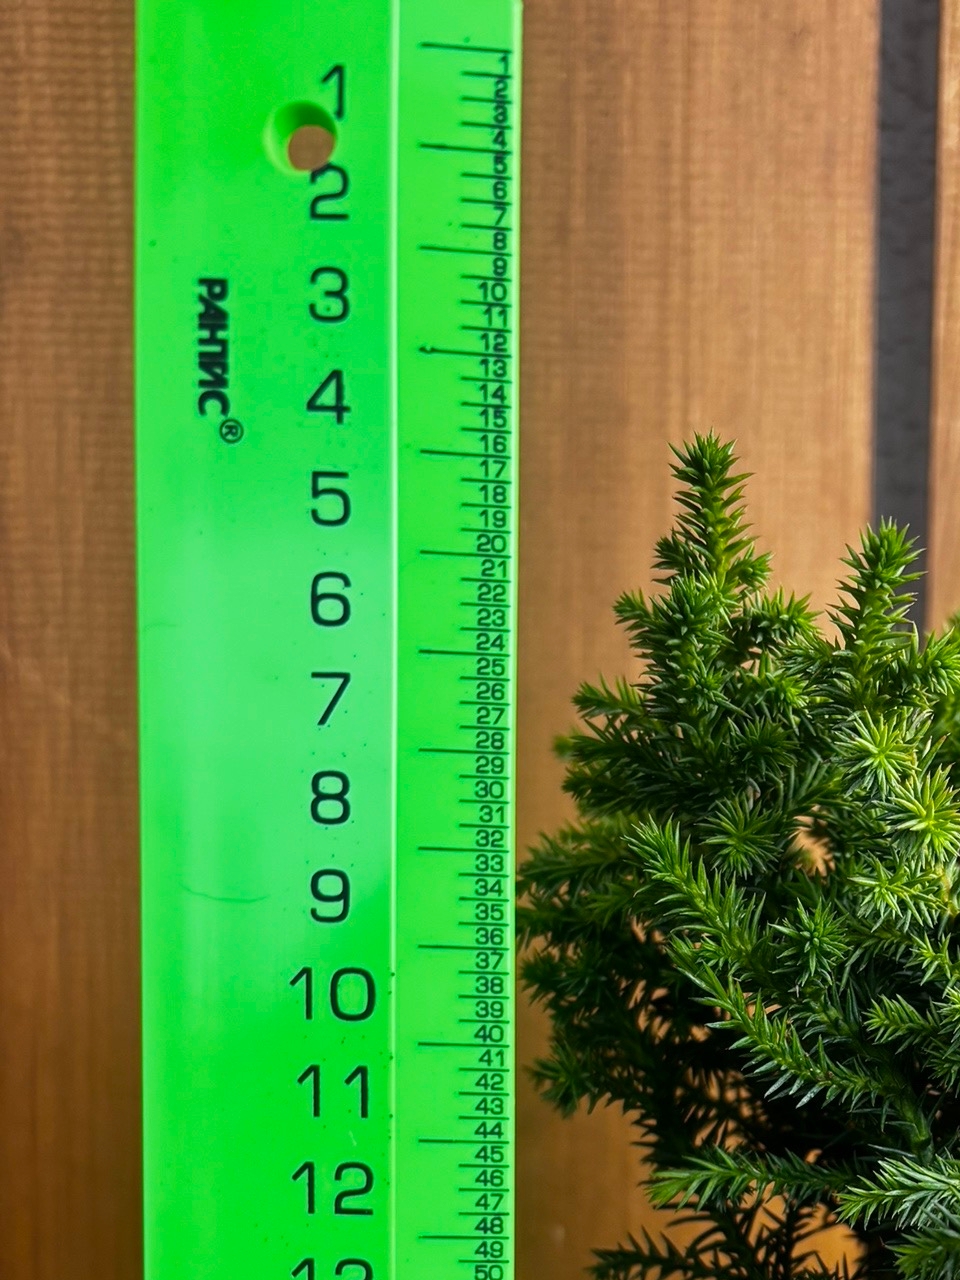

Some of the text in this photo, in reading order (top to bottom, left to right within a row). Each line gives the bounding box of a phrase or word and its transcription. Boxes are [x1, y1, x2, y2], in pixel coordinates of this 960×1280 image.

[499, 54, 509, 72] 1
[319, 65, 346, 120] 1
[492, 131, 507, 148] 4
[309, 165, 351, 220] 2
[492, 181, 507, 199] 6
[496, 207, 507, 225] 7
[492, 232, 507, 250] 8
[309, 266, 349, 323] 3
[478, 283, 508, 301] 10
[483, 308, 508, 326] 11
[480, 333, 507, 351] 12
[479, 359, 507, 376] 13
[306, 369, 350, 424] 4
[479, 384, 506, 402] 14
[479, 409, 507, 427] 15
[480, 434, 507, 452] 16
[479, 459, 507, 477] 17
[311, 471, 350, 526] 5
[479, 484, 507, 502] 18
[479, 509, 507, 527] 19
[476, 534, 507, 552] 20
[481, 559, 507, 576] 21
[311, 571, 351, 627] 6
[477, 584, 506, 601] 22
[477, 609, 506, 626] 23
[476, 633, 506, 651] 24
[476, 658, 506, 676] 25
[311, 672, 350, 725] 7
[476, 683, 505, 700] 26
[476, 708, 505, 725] 27
[475, 732, 505, 750] 28
[475, 757, 505, 774] 29
[311, 770, 350, 825] 8
[474, 781, 505, 799] 30
[479, 806, 505, 823] 31
[475, 830, 504, 848] 32
[475, 855, 504, 872] 33
[310, 869, 350, 923] 9
[474, 879, 504, 896] 34
[475, 904, 504, 921] 35
[475, 928, 504, 945] 36
[475, 952, 504, 969] 37
[290, 967, 376, 1021] 10
[475, 977, 504, 994] 38
[475, 1001, 504, 1018] 39
[473, 1025, 504, 1042] 40
[478, 1049, 505, 1066] 41
[475, 1073, 504, 1090] 42
[297, 1065, 368, 1118] 11
[474, 1098, 504, 1114] 43
[474, 1122, 504, 1138] 44
[474, 1146, 504, 1162] 45
[474, 1170, 504, 1186] 46
[292, 1162, 373, 1215] 12
[474, 1193, 504, 1210] 47
[474, 1217, 504, 1234] 48
[474, 1241, 504, 1258] 49
[474, 1265, 504, 1280] 50
